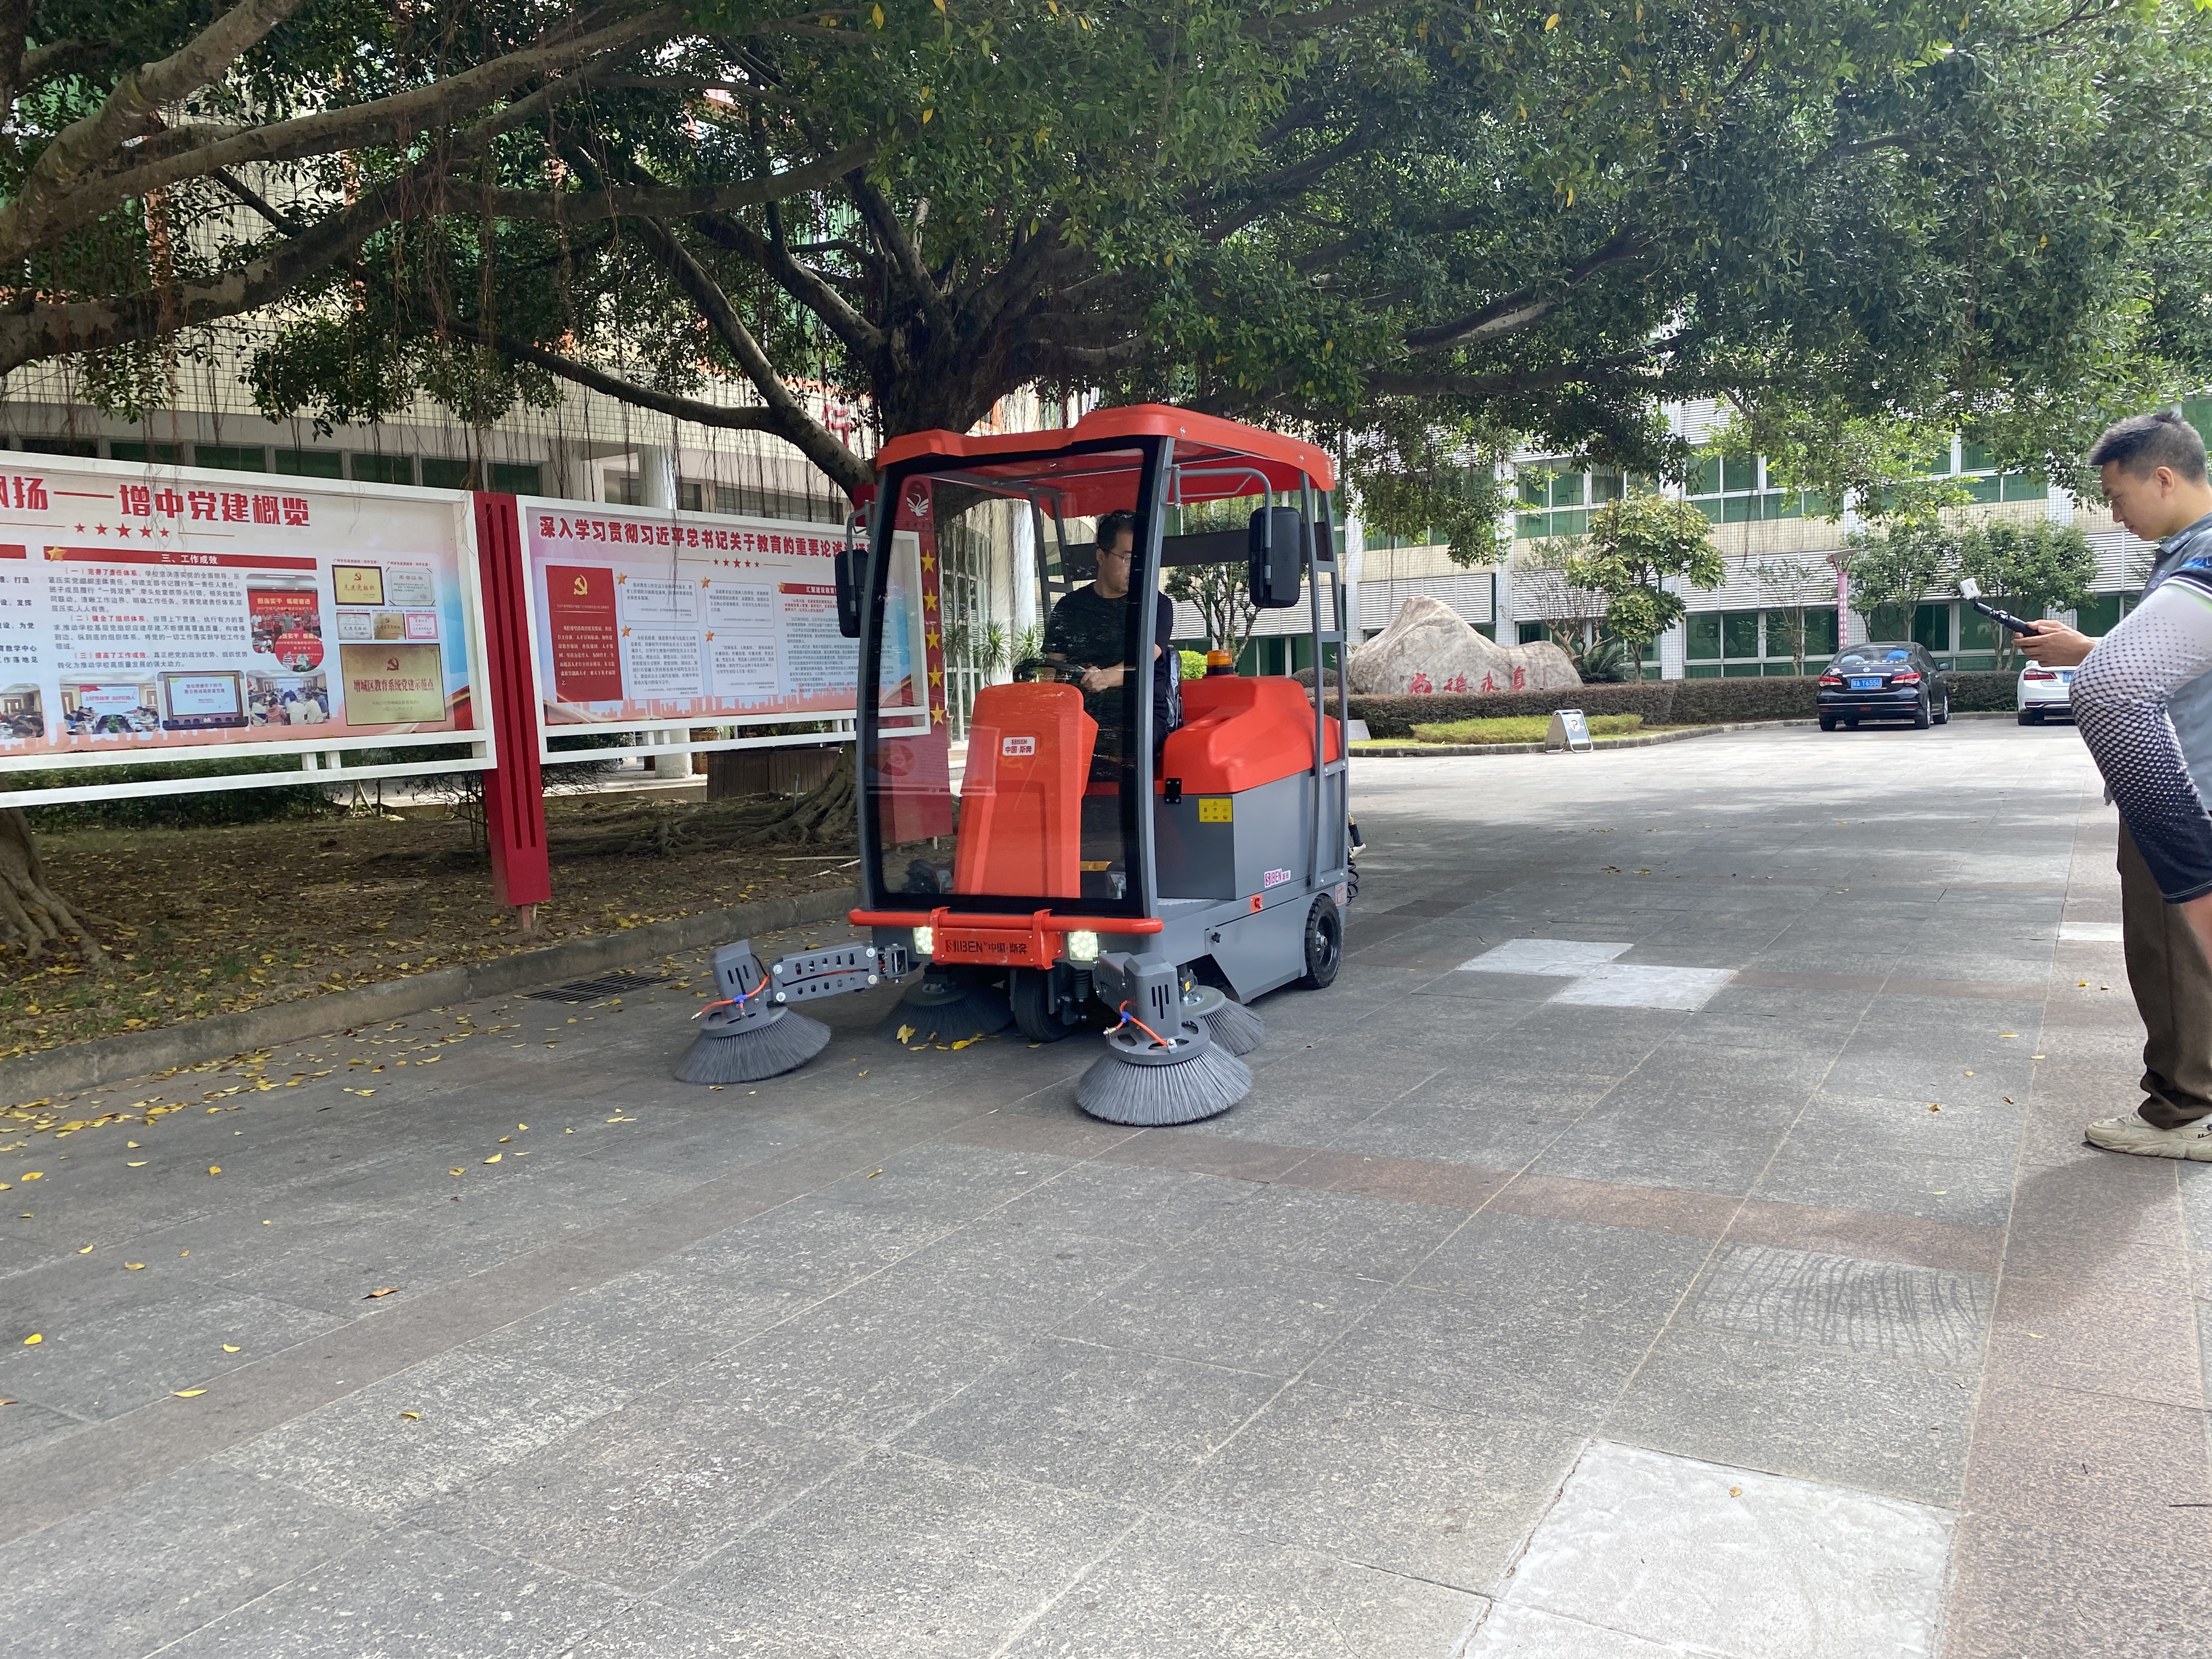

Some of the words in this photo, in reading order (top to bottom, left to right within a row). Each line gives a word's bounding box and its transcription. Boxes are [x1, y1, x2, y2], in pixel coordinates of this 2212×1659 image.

[0, 476, 311, 526] 扬——增中党建概览
[161, 554, 218, 565] 三、工作成效
[1265, 870, 1282, 887] SIBEN
